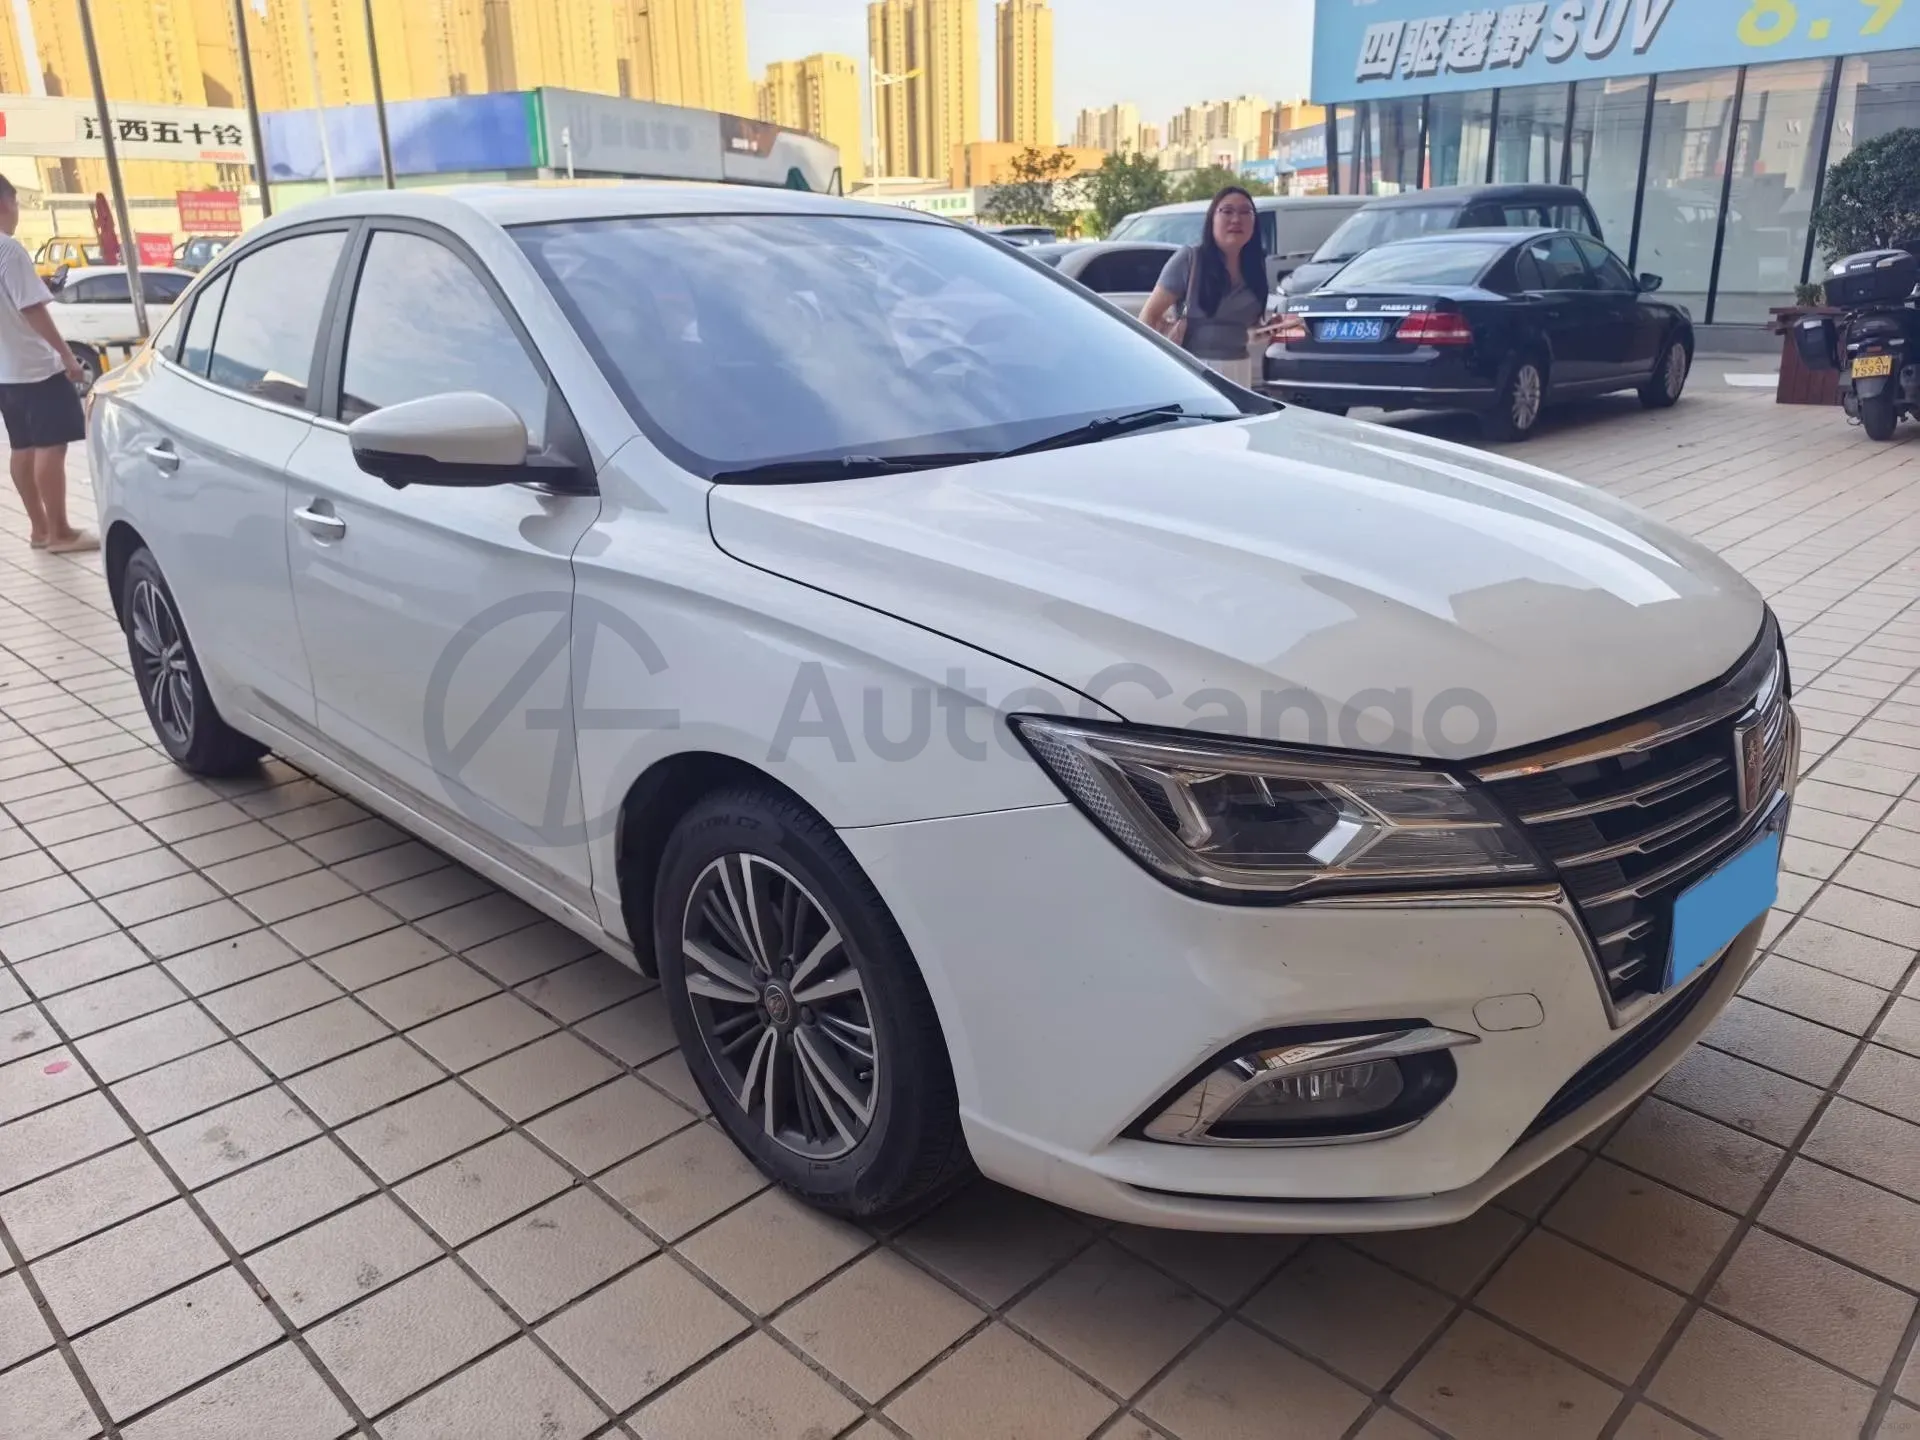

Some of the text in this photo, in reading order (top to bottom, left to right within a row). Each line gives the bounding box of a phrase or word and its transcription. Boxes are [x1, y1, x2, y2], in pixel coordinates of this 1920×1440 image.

[84, 116, 243, 146] 江西五十铃
